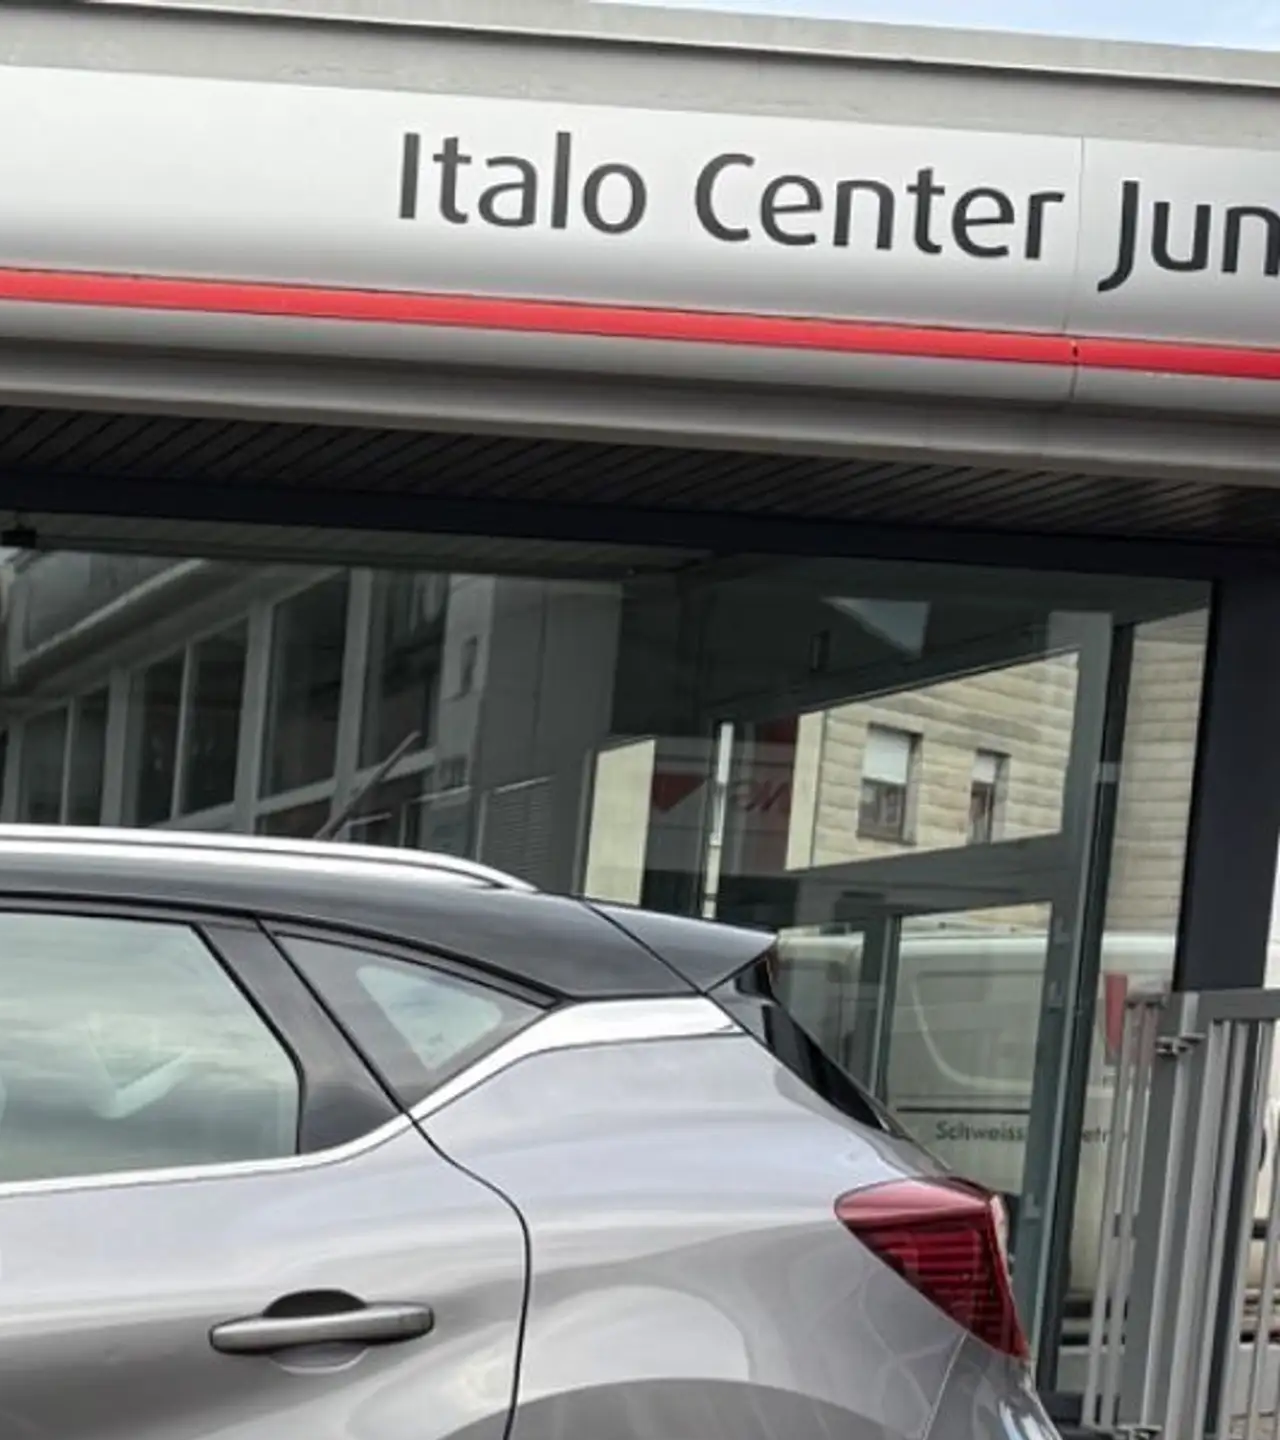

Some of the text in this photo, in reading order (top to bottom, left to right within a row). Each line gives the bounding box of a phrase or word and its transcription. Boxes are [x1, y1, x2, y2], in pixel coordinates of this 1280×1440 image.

[399, 132, 1280, 293] Italo Center Jun
